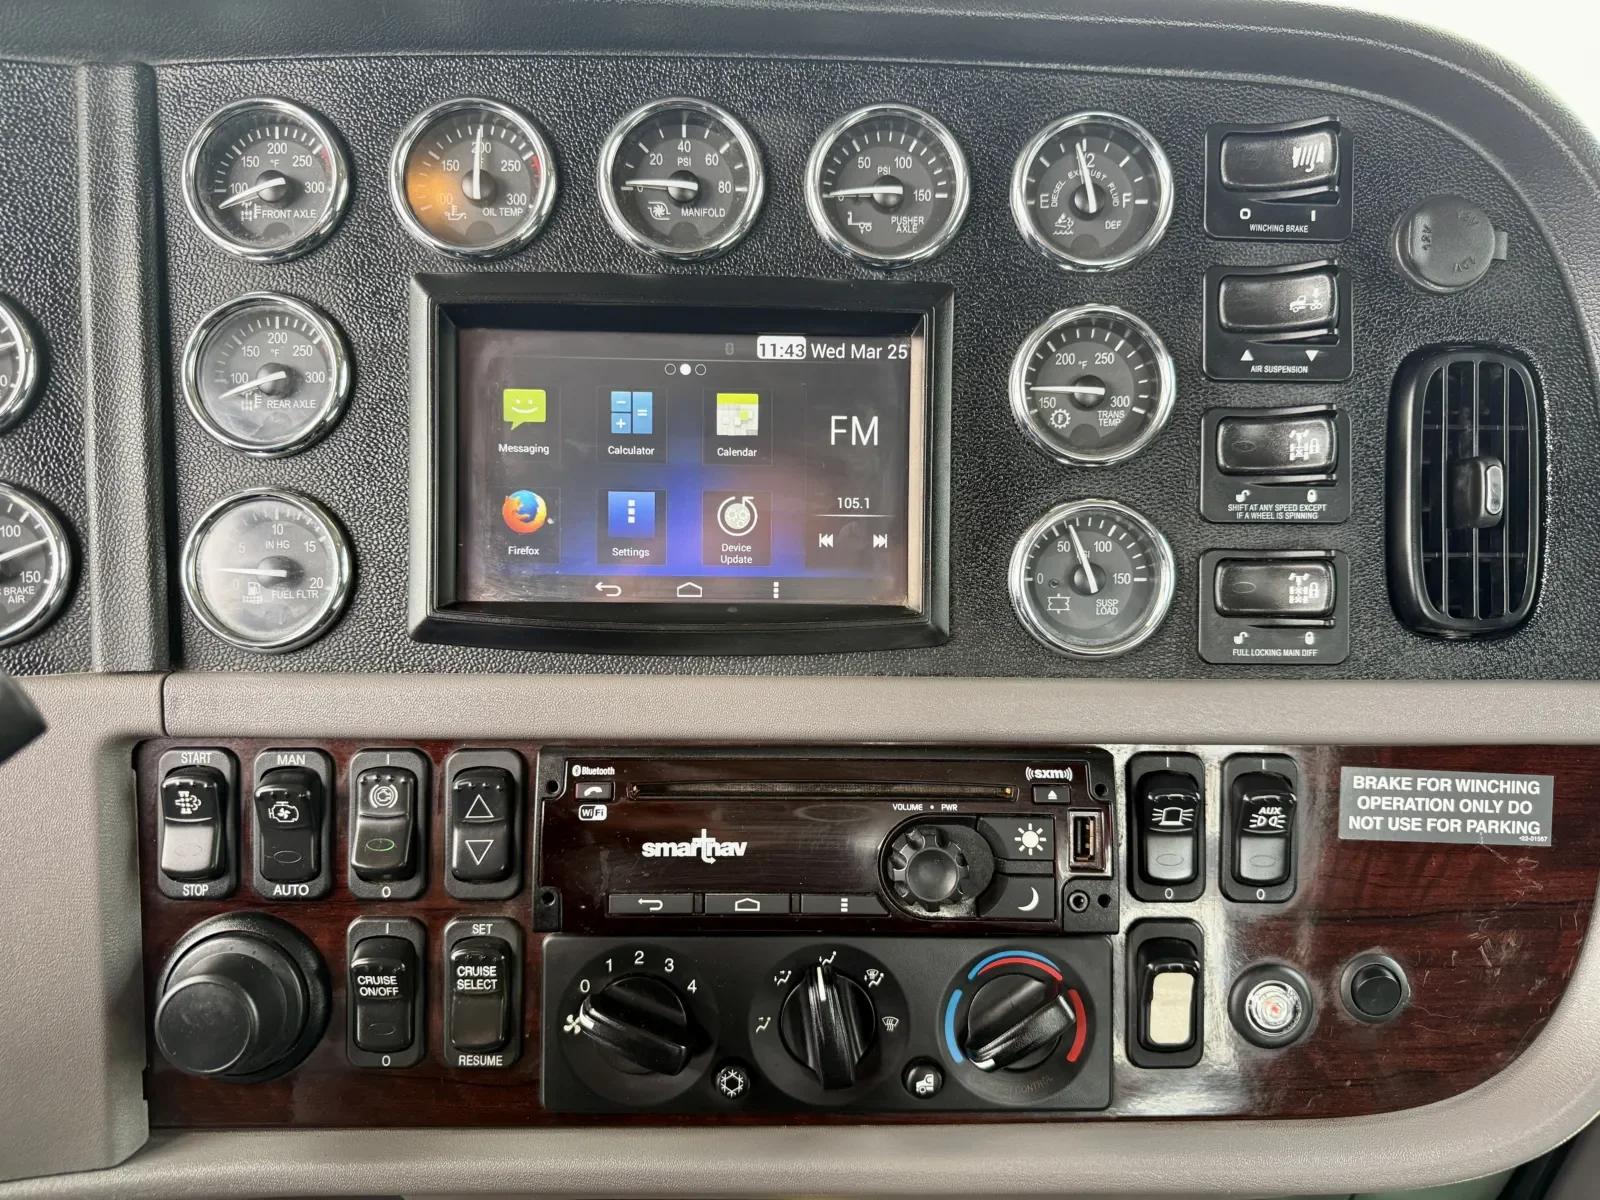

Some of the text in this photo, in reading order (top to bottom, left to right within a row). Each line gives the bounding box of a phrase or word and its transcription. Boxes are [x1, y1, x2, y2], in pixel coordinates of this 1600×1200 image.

[267, 143, 287, 154] 200
[677, 141, 691, 153] 40
[241, 156, 259, 168] 150
[292, 156, 312, 167] 250
[442, 160, 459, 171] 150
[650, 154, 663, 166] 20
[677, 158, 691, 167] PSI
[705, 154, 719, 166] 60
[858, 157, 871, 169] 50
[894, 157, 912, 169] 100
[501, 160, 521, 172] 250
[877, 166, 890, 175] PSI
[230, 183, 248, 194] 100
[304, 182, 324, 193] 300
[718, 181, 732, 193] 80
[1051, 181, 1066, 207] DIESEL
[1068, 169, 1107, 181] EXUST
[507, 194, 526, 206] 300
[913, 189, 931, 201] 150
[1123, 193, 1132, 208] F
[1040, 194, 1049, 208] E
[262, 210, 317, 218] FRONT AXLE
[482, 208, 523, 217] OIL TEMP
[681, 208, 726, 218] MANIFOLD
[891, 216, 924, 225] PUSHER
[1105, 221, 1122, 230] DEF
[896, 225, 918, 233] AXLE
[1250, 224, 1308, 232] WINCHING BRAKE
[267, 333, 287, 344] 200
[242, 346, 260, 357] 150
[292, 345, 312, 357] 250
[759, 343, 908, 359] 11:43 Wed Mar 25
[1056, 353, 1075, 365] 200
[1095, 352, 1115, 364] 250
[1250, 365, 1308, 373] AIR SUSPENSION
[230, 373, 248, 384] 100
[305, 372, 325, 383] 300
[267, 400, 316, 409] REAR AXLE
[1039, 397, 1056, 409] 150
[1110, 396, 1130, 408] 300
[1097, 410, 1125, 419] TRANS
[1099, 419, 1122, 427] TEMP
[830, 416, 879, 446] FM
[498, 444, 550, 456] Messaging
[608, 446, 655, 455] Calculator
[717, 448, 757, 457] Calendar
[837, 497, 870, 509] 105.1
[1, 525, 21, 537] 100
[272, 524, 283, 535] 10
[266, 540, 290, 549] IN HG
[304, 541, 316, 552] 15
[721, 543, 752, 552] Device
[1057, 541, 1070, 553] 50
[1094, 541, 1112, 553] 100
[508, 546, 540, 556] Firefox
[612, 547, 650, 558] Settings
[720, 555, 753, 565] Update
[20, 571, 41, 583] 150
[309, 577, 323, 588] 20
[1037, 573, 1043, 585] 0
[1113, 573, 1131, 585] 150
[4, 586, 35, 595] BRAKE
[272, 590, 319, 599] FUEL FLTR
[8, 595, 25, 604] AIR
[1096, 599, 1119, 607] SUSP
[1096, 607, 1119, 615] LOAD
[181, 753, 212, 764] START
[277, 755, 306, 765] MAN
[581, 766, 615, 776] Bluetooth
[1353, 775, 1540, 795] BRAKE FOR WINCHING
[1357, 796, 1533, 814] OPERATION ONLY DO
[1258, 807, 1282, 815] AUX
[1349, 816, 1540, 835] NOT USE FOR PARKING
[183, 884, 209, 896] STOP
[273, 884, 309, 896] AUTO
[472, 924, 493, 935] SET
[634, 951, 645, 965] 2
[606, 959, 612, 973] 1
[664, 958, 675, 973] 3
[457, 966, 497, 977] CRUISE
[357, 975, 397, 985] CRUISE
[457, 979, 498, 990] SELECT
[580, 979, 591, 993] 0
[687, 979, 697, 994] 4
[359, 987, 399, 997] ON/OFF
[458, 1055, 503, 1066] RESUME
